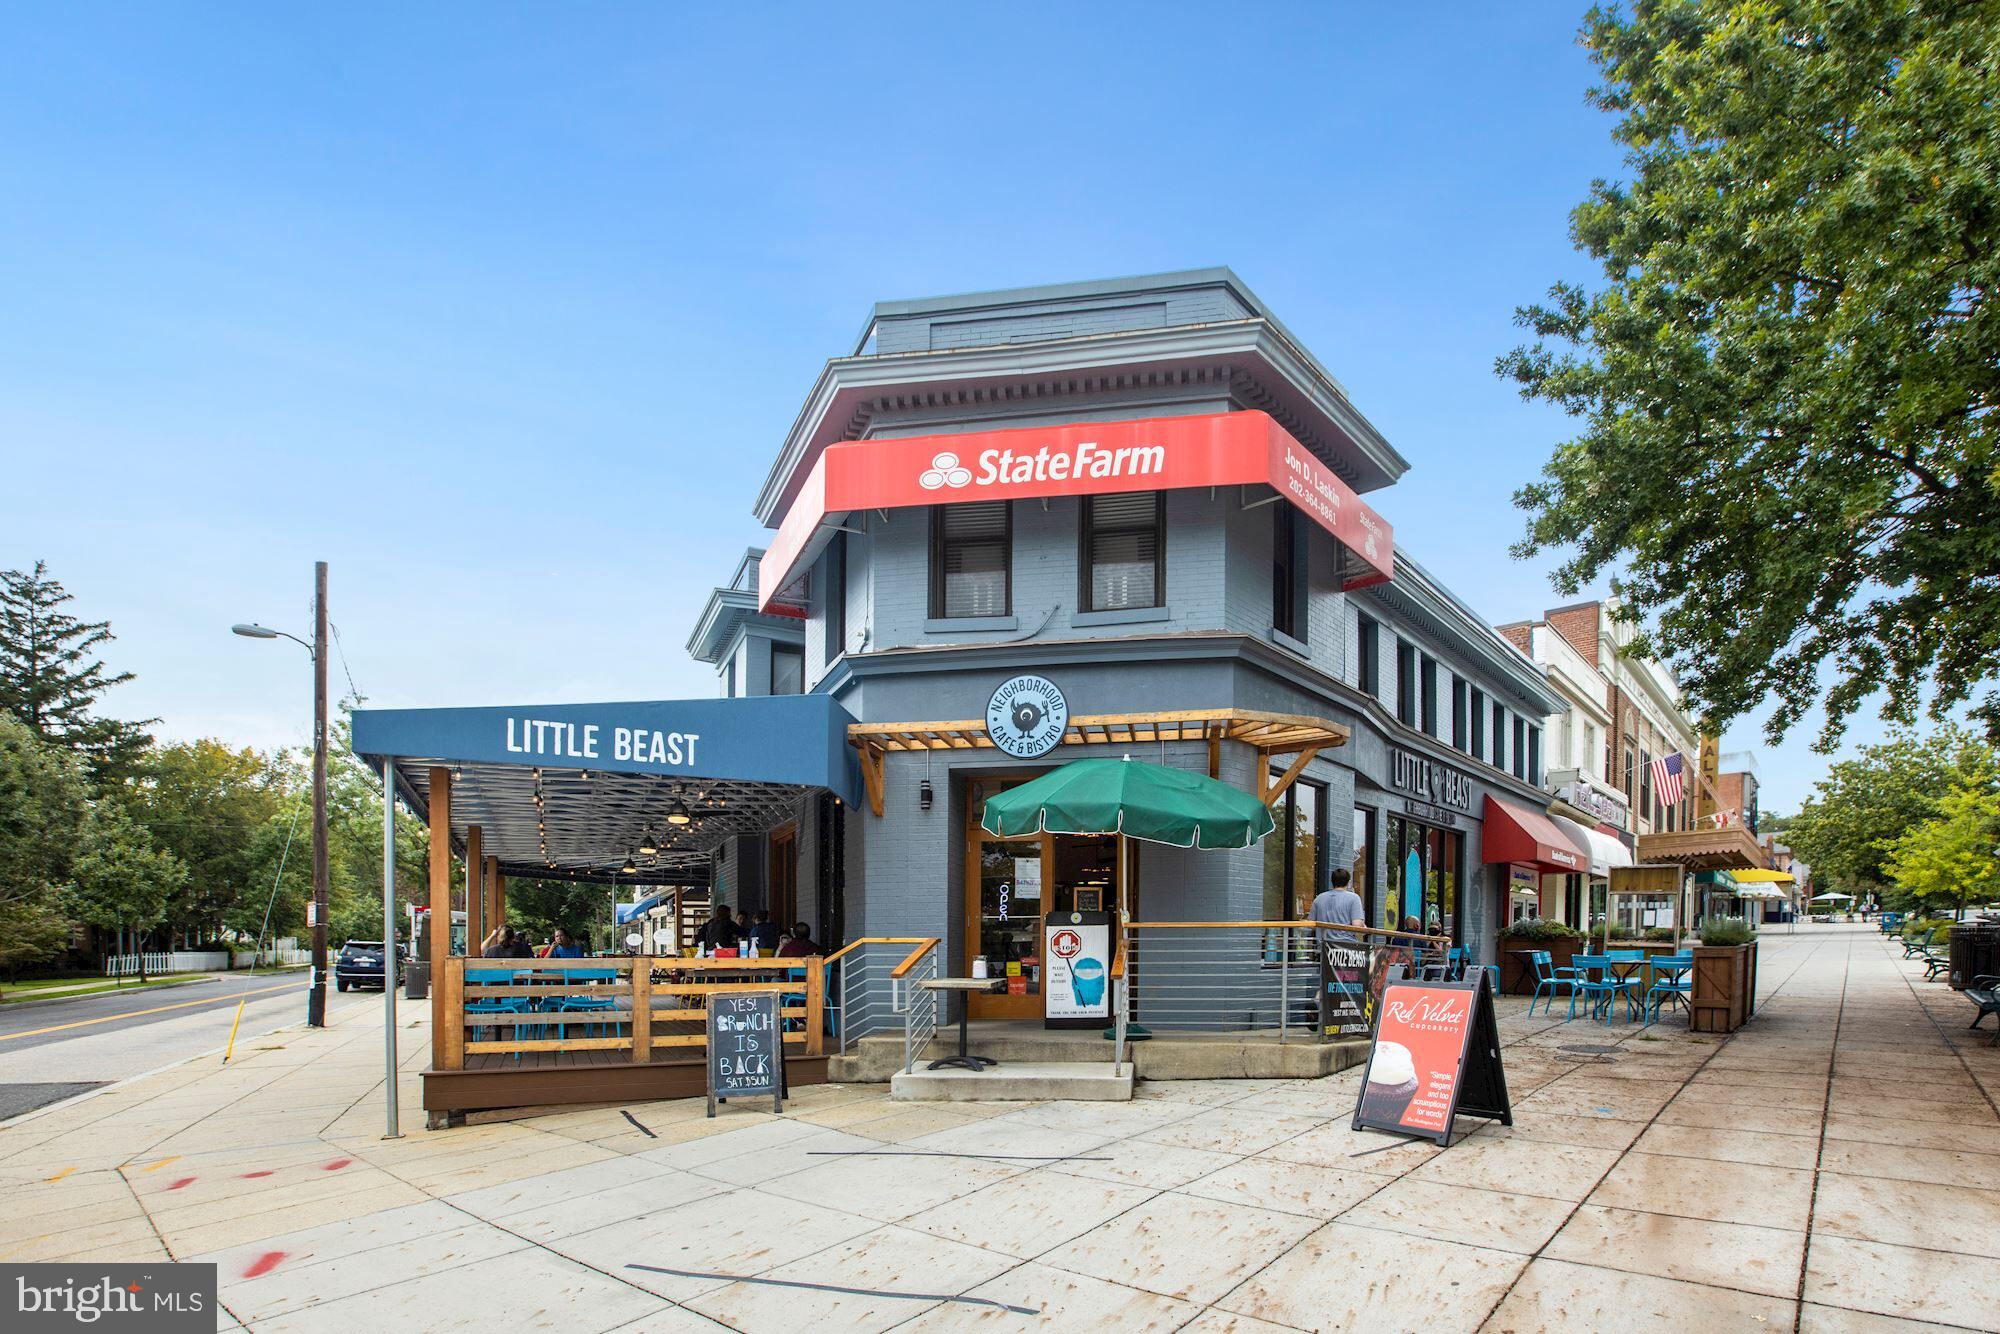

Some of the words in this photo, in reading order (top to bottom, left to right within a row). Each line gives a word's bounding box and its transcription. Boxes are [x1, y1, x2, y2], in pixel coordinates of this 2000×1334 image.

[1285, 447, 1302, 475] Jon
[1303, 462, 1313, 485] D.
[1314, 472, 1340, 508] Laskin
[1289, 476, 1337, 525] 202-364-8861
[991, 678, 1064, 713] NEIGHBORHOOD
[506, 717, 600, 759] LITTLE
[614, 727, 700, 767] BEAST
[992, 725, 1017, 752] CAFE
[1017, 742, 1024, 754] &
[1026, 724, 1061, 754] BISTRO
[1394, 748, 1430, 797] LITTLE
[1445, 768, 1474, 811] BEAST
[729, 997, 757, 1012] YES!
[1387, 996, 1427, 1024] Red
[1422, 999, 1464, 1024] Velvet
[717, 1012, 774, 1032] BRUNCH
[1410, 1023, 1459, 1034] cupcakery
[734, 1034, 759, 1053] IS
[720, 1054, 770, 1075] BACK
[726, 1077, 743, 1088] SAT
[1430, 1081, 1451, 1090] elegant
[1413, 1100, 1447, 1108] scrumptious
